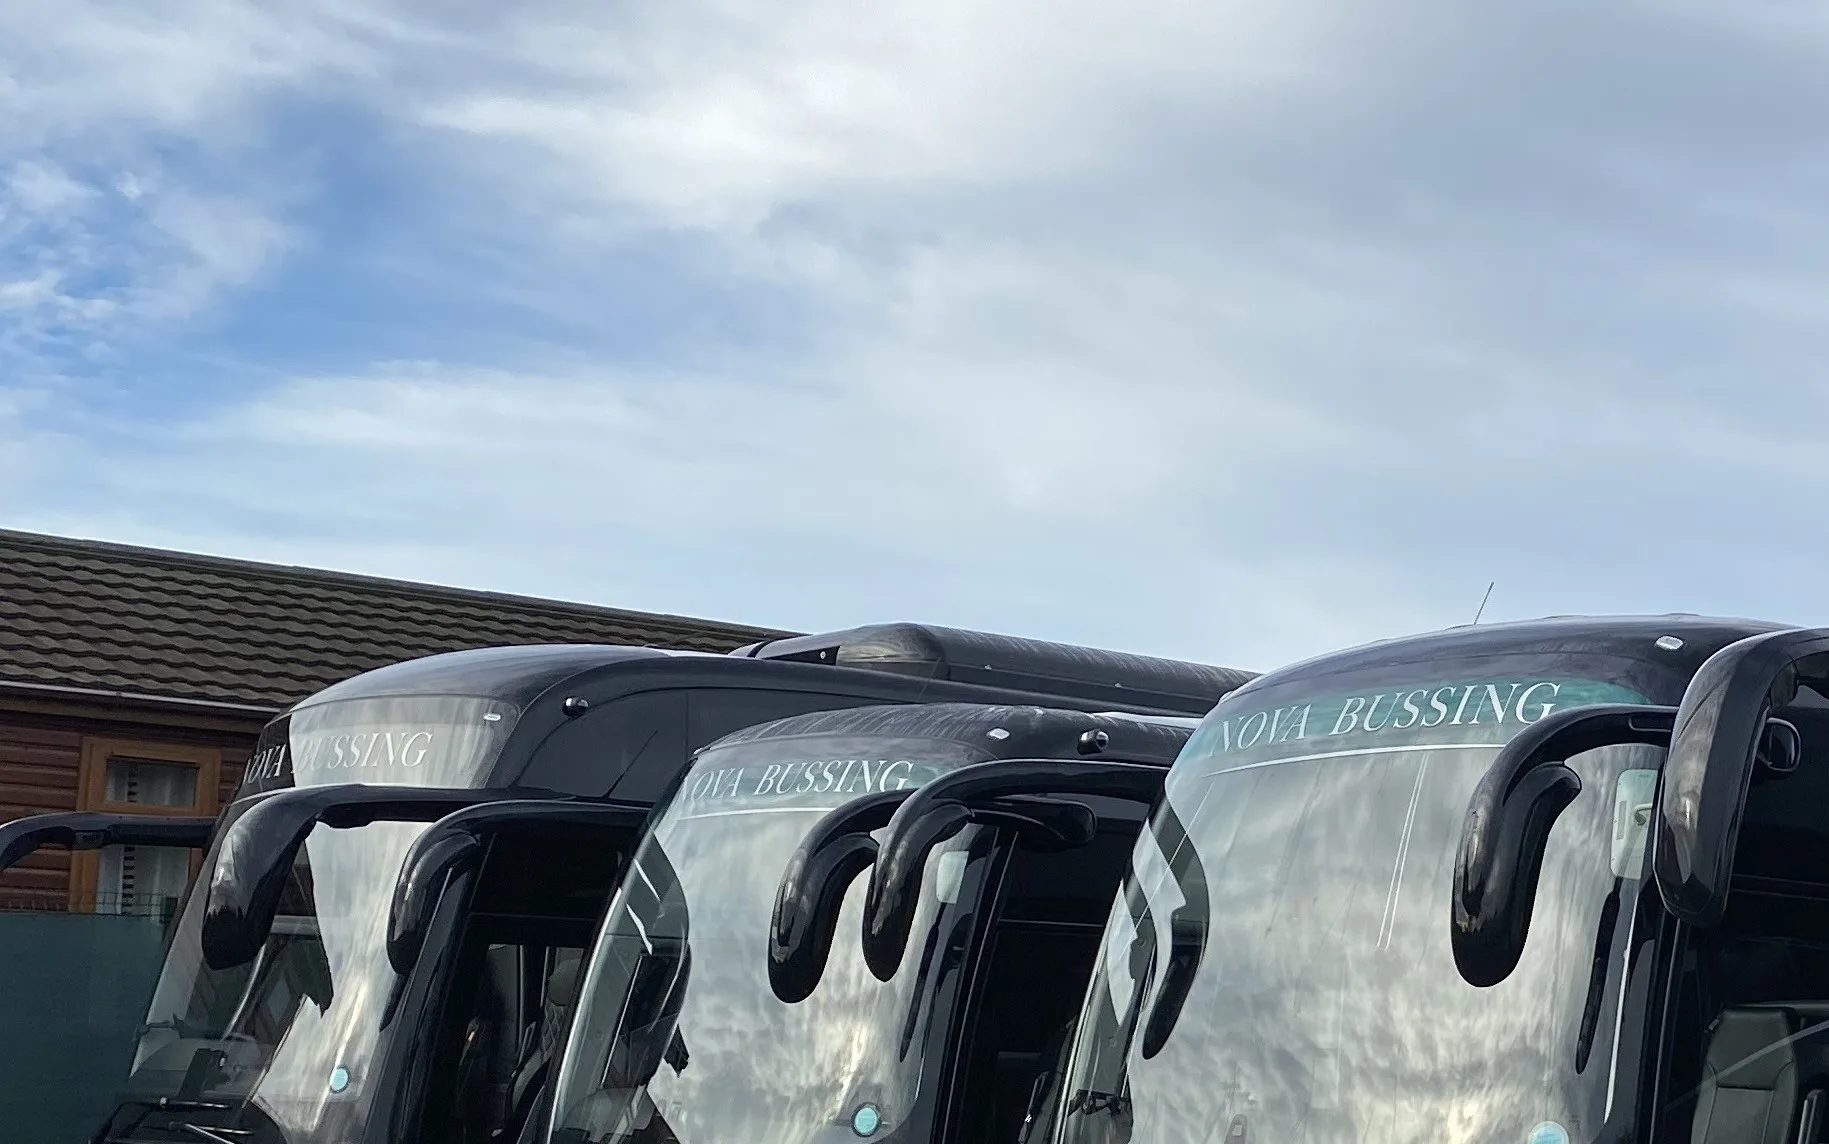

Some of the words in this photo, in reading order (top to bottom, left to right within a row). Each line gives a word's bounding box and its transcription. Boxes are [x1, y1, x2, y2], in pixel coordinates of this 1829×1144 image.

[1208, 703, 1312, 758] NOVA
[1328, 682, 1562, 737] BUSSING
[753, 759, 915, 796] BUSSING
